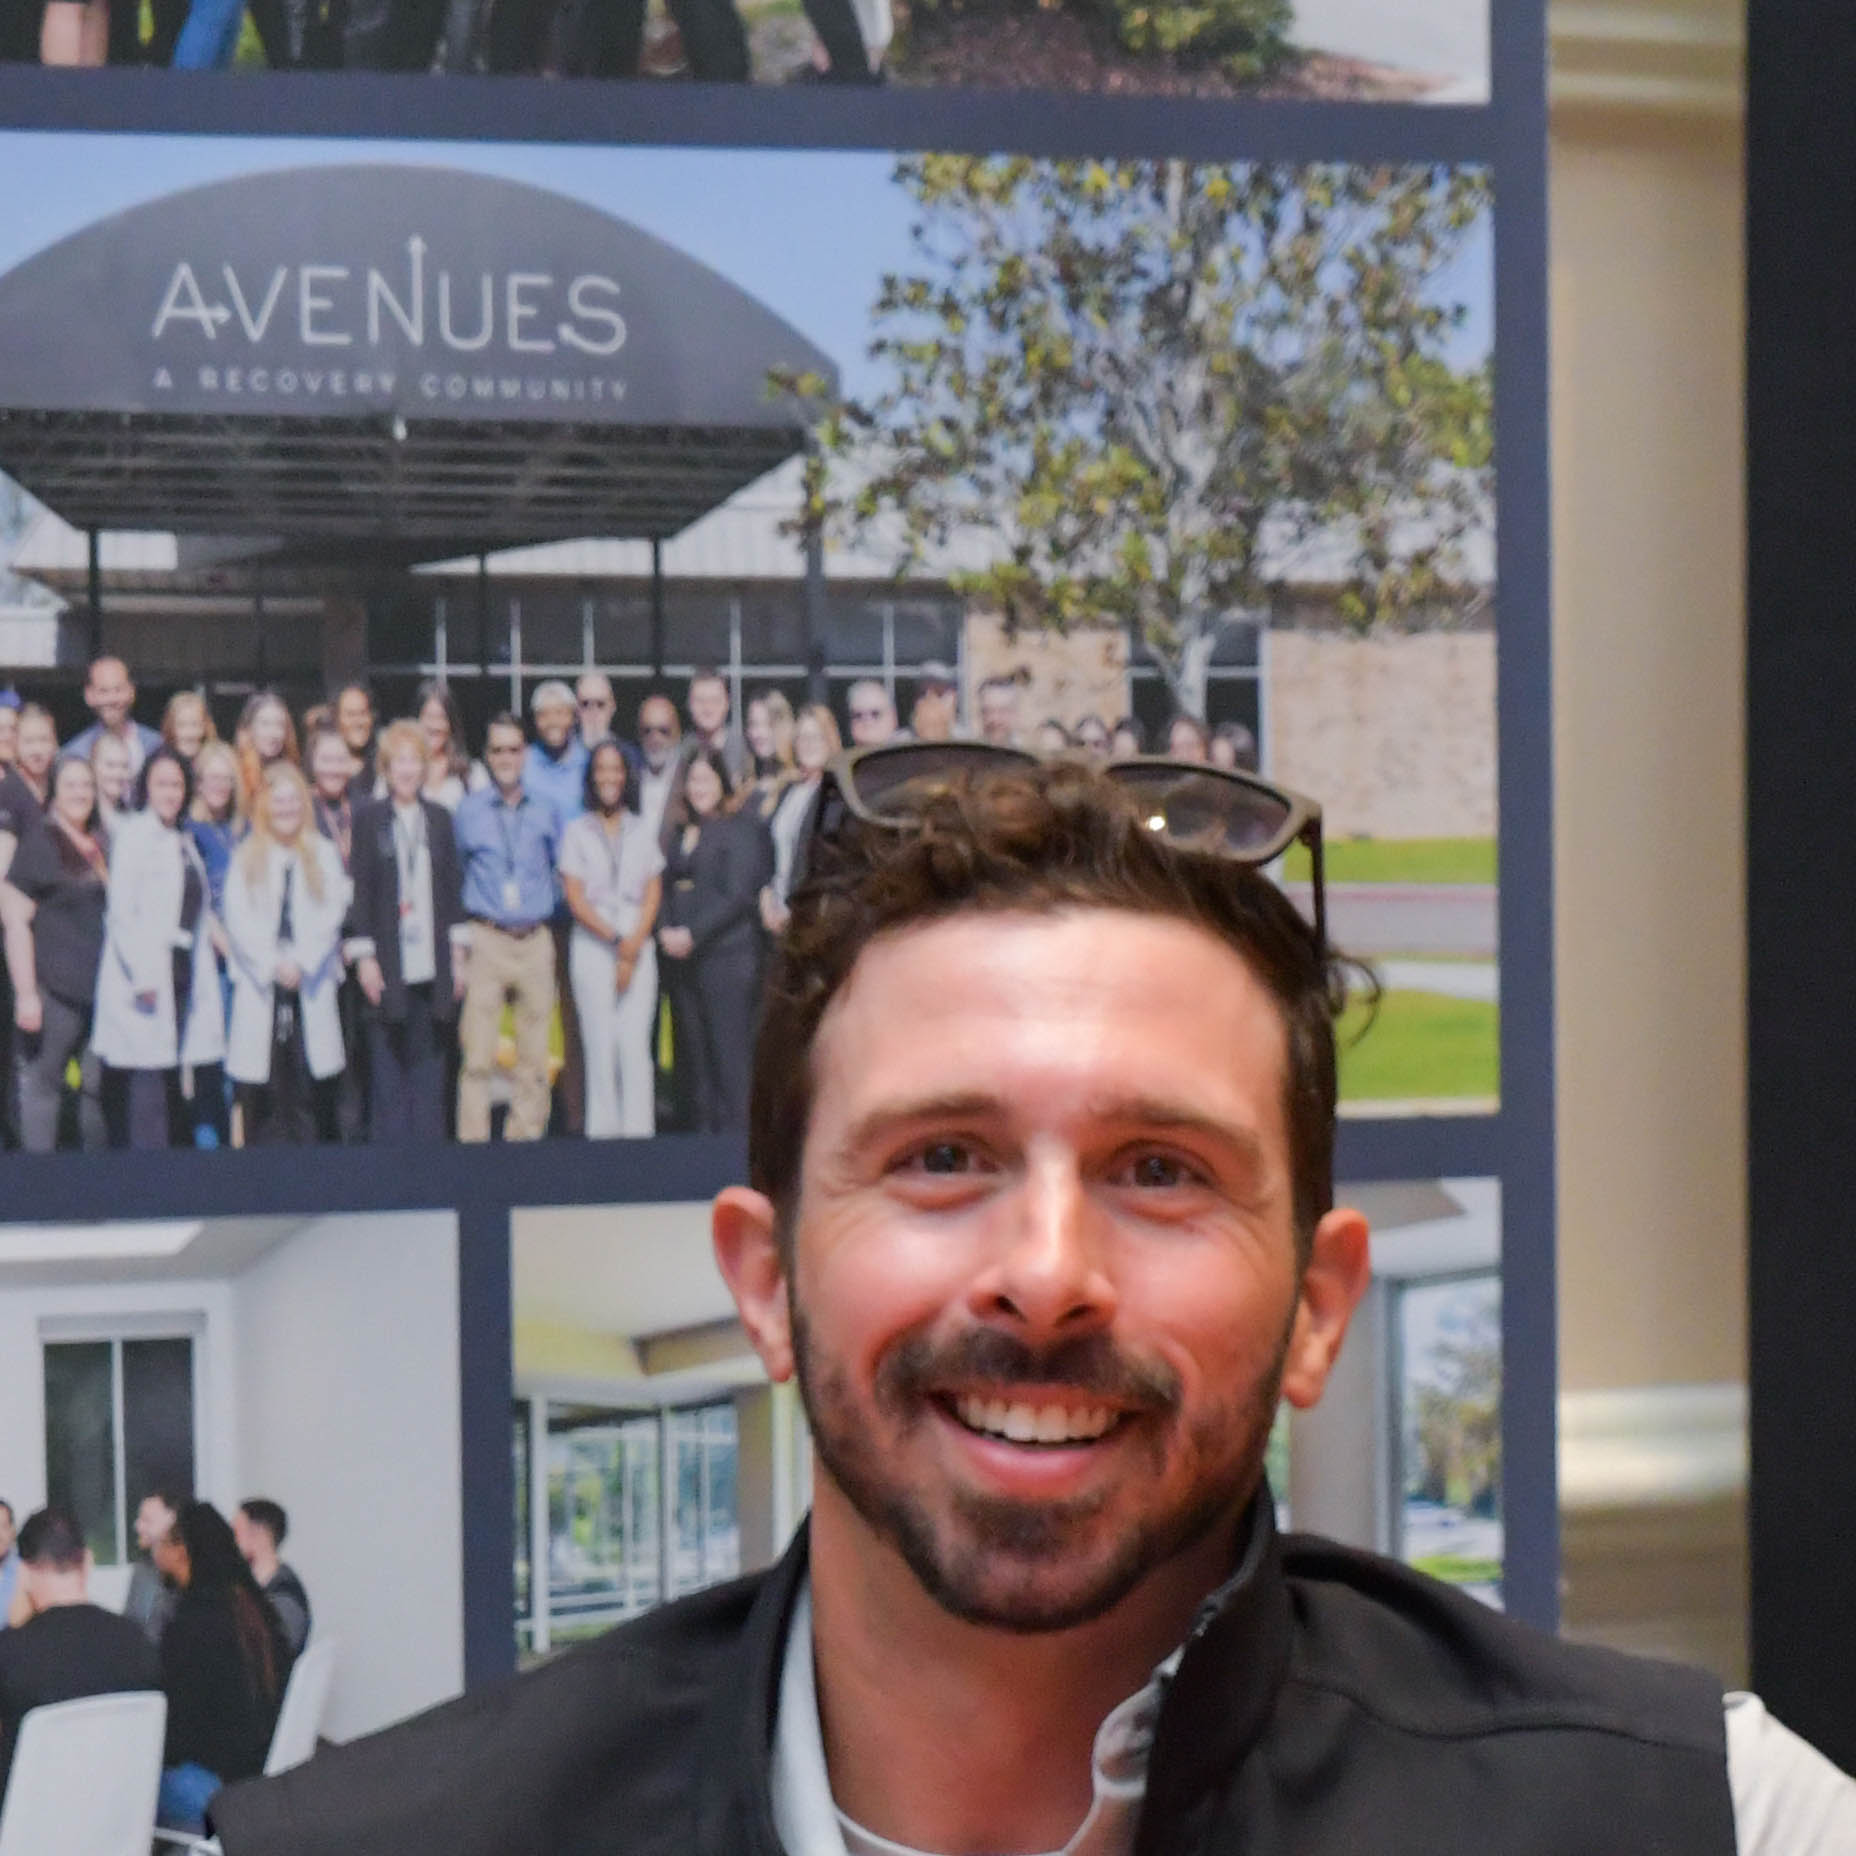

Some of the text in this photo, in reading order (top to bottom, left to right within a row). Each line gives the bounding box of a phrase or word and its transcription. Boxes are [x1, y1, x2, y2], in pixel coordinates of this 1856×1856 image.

[152, 233, 628, 355] AVENUES
[153, 367, 628, 400] A RECOVERY COMMUNITY
